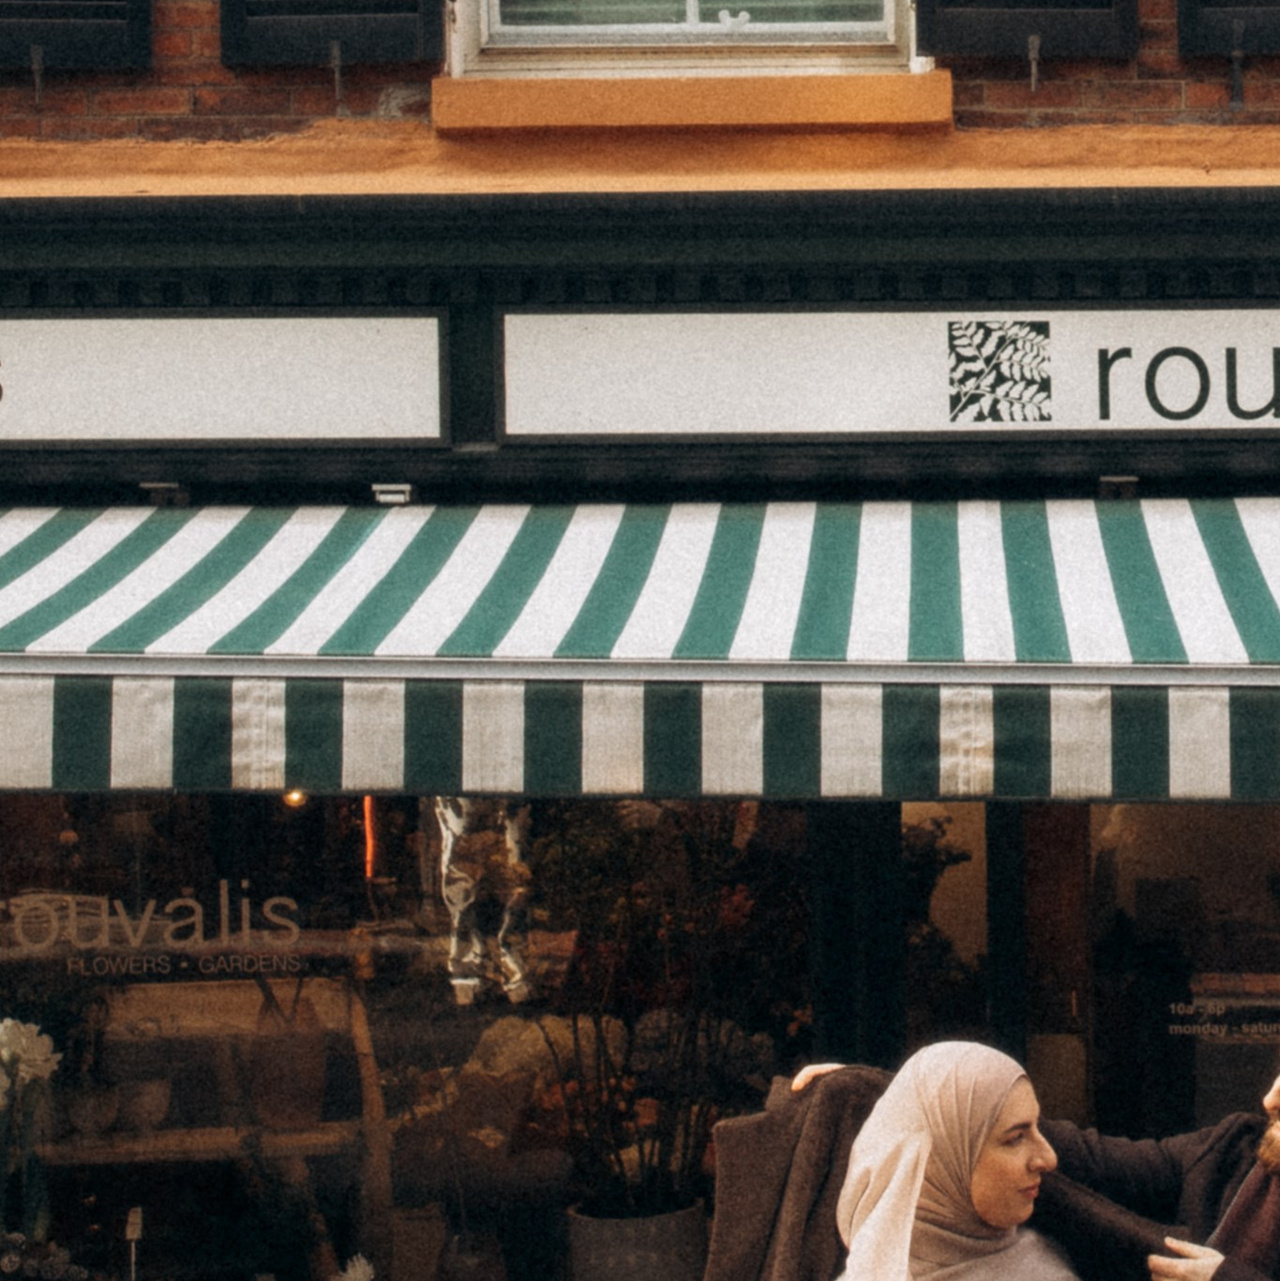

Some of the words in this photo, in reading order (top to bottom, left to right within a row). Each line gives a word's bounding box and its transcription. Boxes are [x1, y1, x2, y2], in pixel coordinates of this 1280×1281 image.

[0, 879, 299, 950] ouvalis
[67, 956, 171, 976] FLOWERS
[198, 954, 301, 972] GARDENS
[1169, 1022, 1227, 1037] monday
